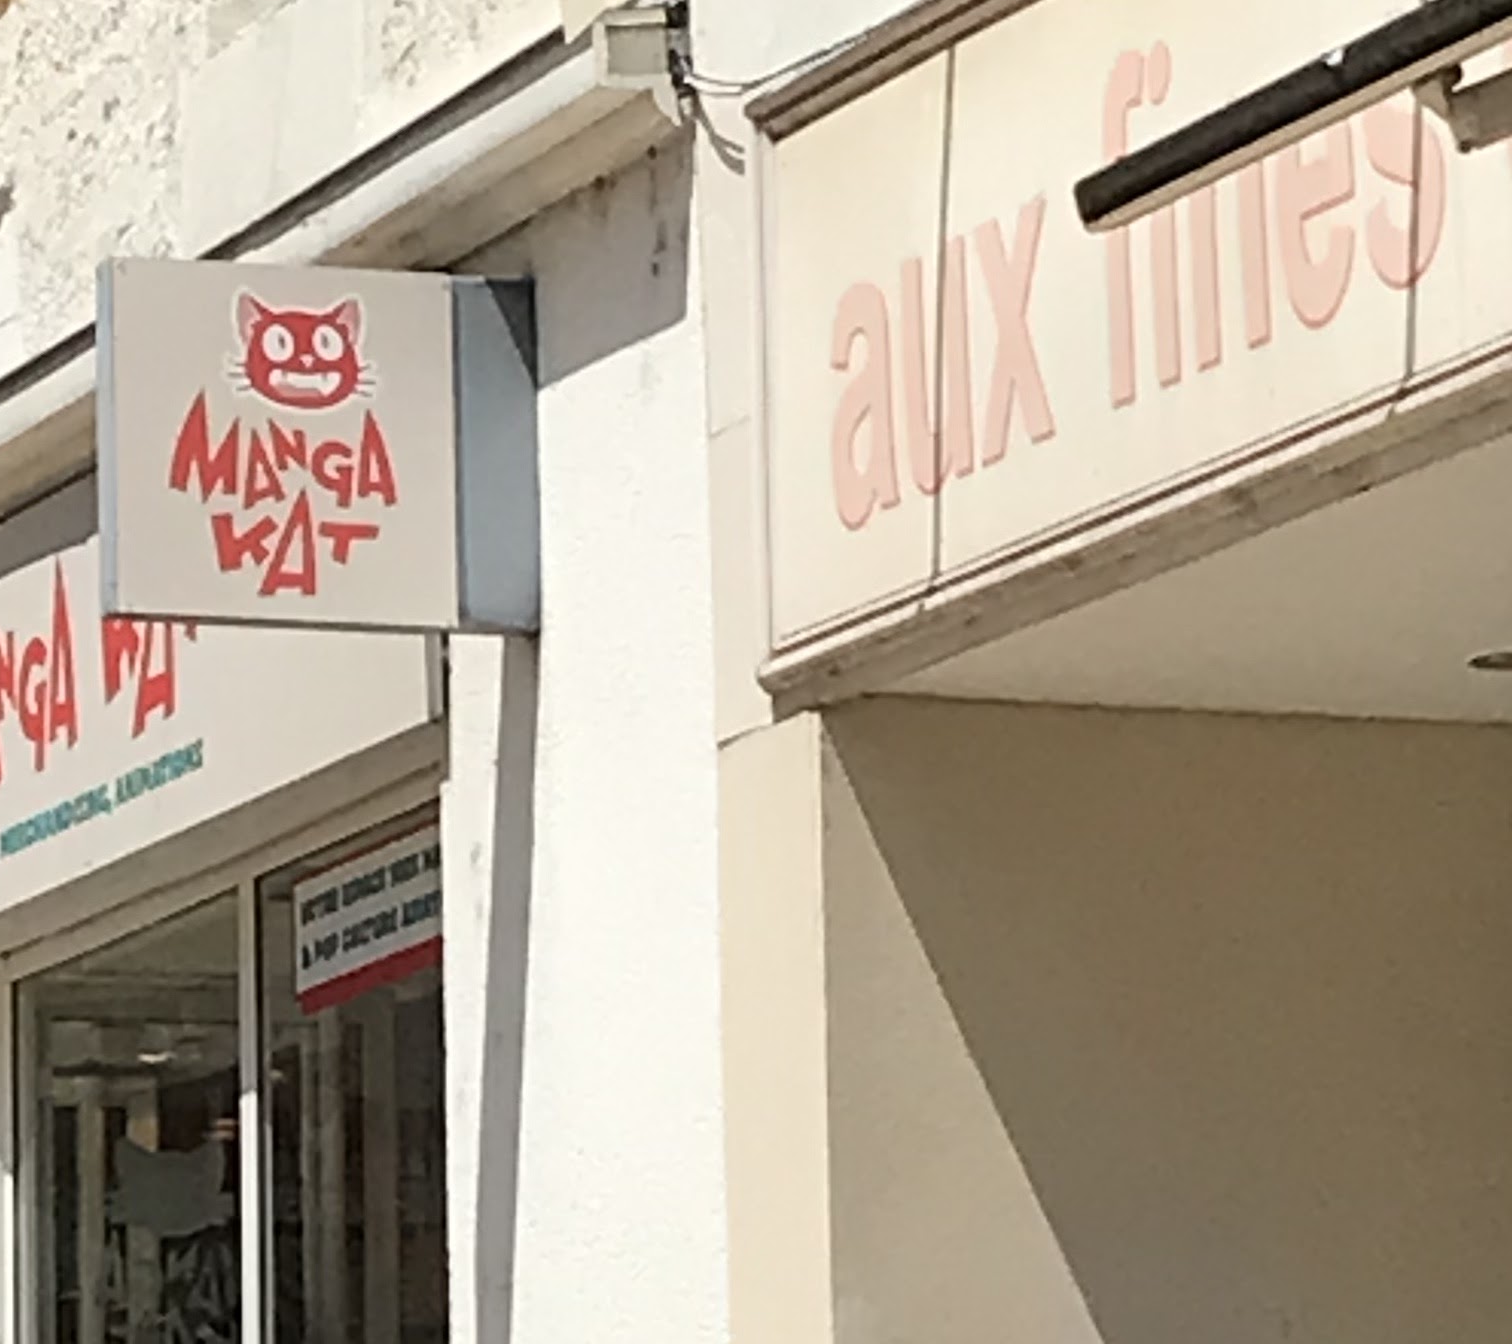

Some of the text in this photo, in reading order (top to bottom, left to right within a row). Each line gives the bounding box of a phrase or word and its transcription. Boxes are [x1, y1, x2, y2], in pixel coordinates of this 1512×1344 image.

[829, 193, 1057, 532] aux
[169, 390, 399, 511] MANGA
[210, 487, 380, 597] KAT
[101, 616, 197, 739] KA
